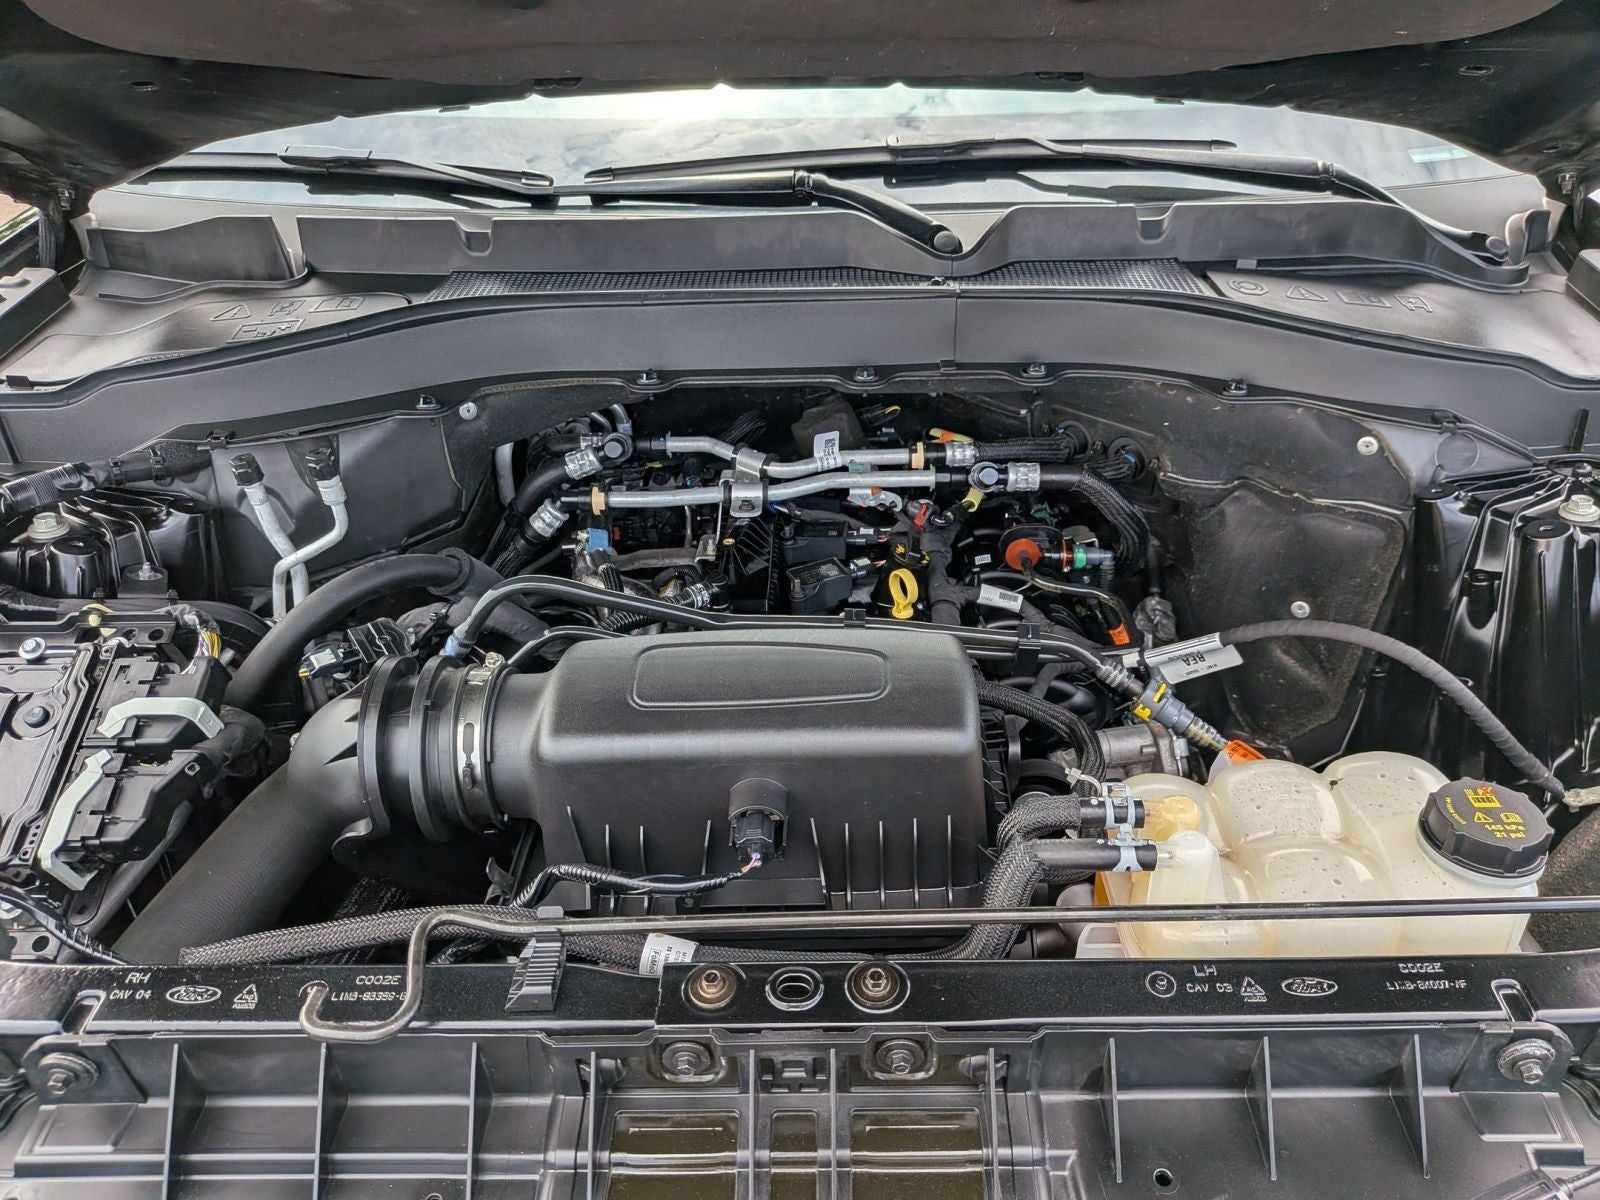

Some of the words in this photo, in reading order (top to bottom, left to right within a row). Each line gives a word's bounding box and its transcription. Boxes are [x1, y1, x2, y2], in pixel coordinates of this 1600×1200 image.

[1192, 964, 1217, 977] LH
[125, 972, 151, 984] RH
[1186, 983, 1209, 993] CAV
[1216, 983, 1233, 993] 03
[109, 989, 133, 1000] CAV
[135, 989, 152, 1000] 04
